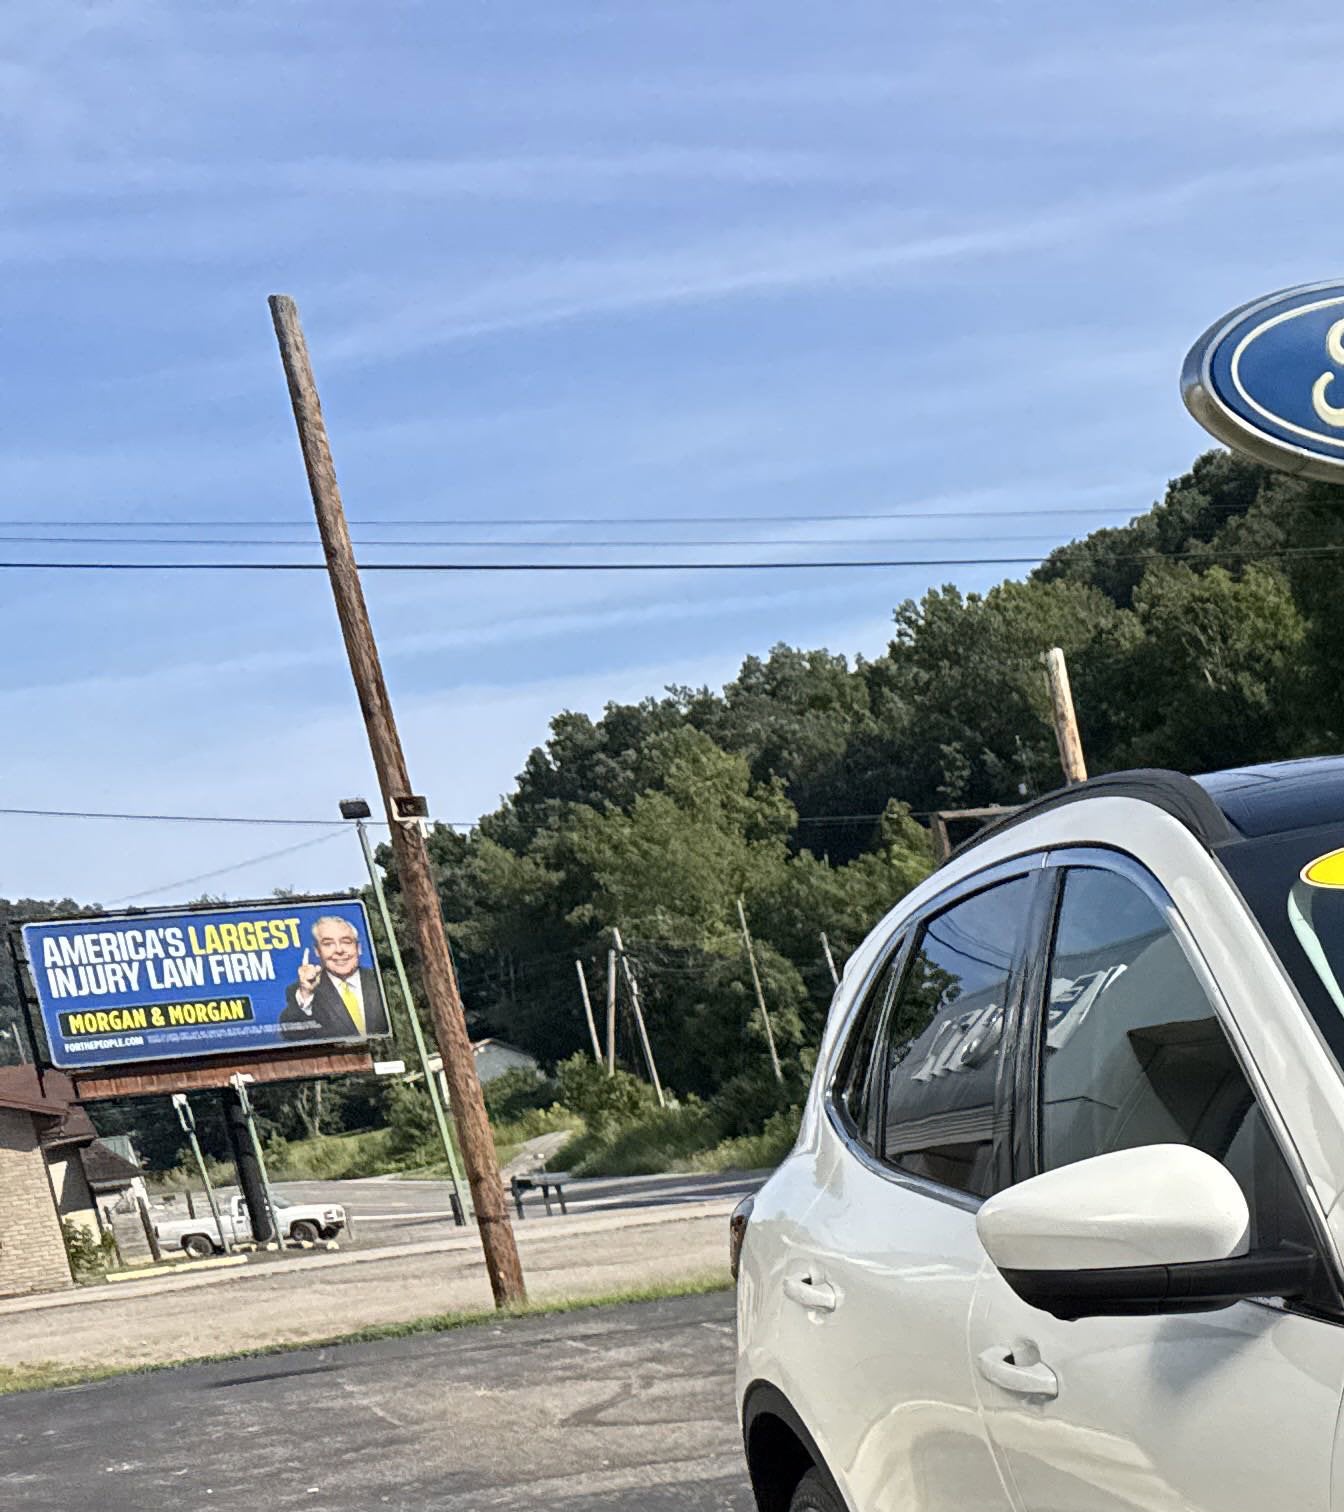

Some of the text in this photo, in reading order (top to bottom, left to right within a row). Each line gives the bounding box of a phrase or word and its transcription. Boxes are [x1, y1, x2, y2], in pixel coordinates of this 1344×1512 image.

[43, 918, 301, 967] AMERICA'S LARGEST
[46, 951, 275, 999] INJURY LAW FIRM
[68, 1008, 147, 1035] MORGAN
[151, 1007, 165, 1027] &
[168, 1001, 245, 1026] MORGAN
